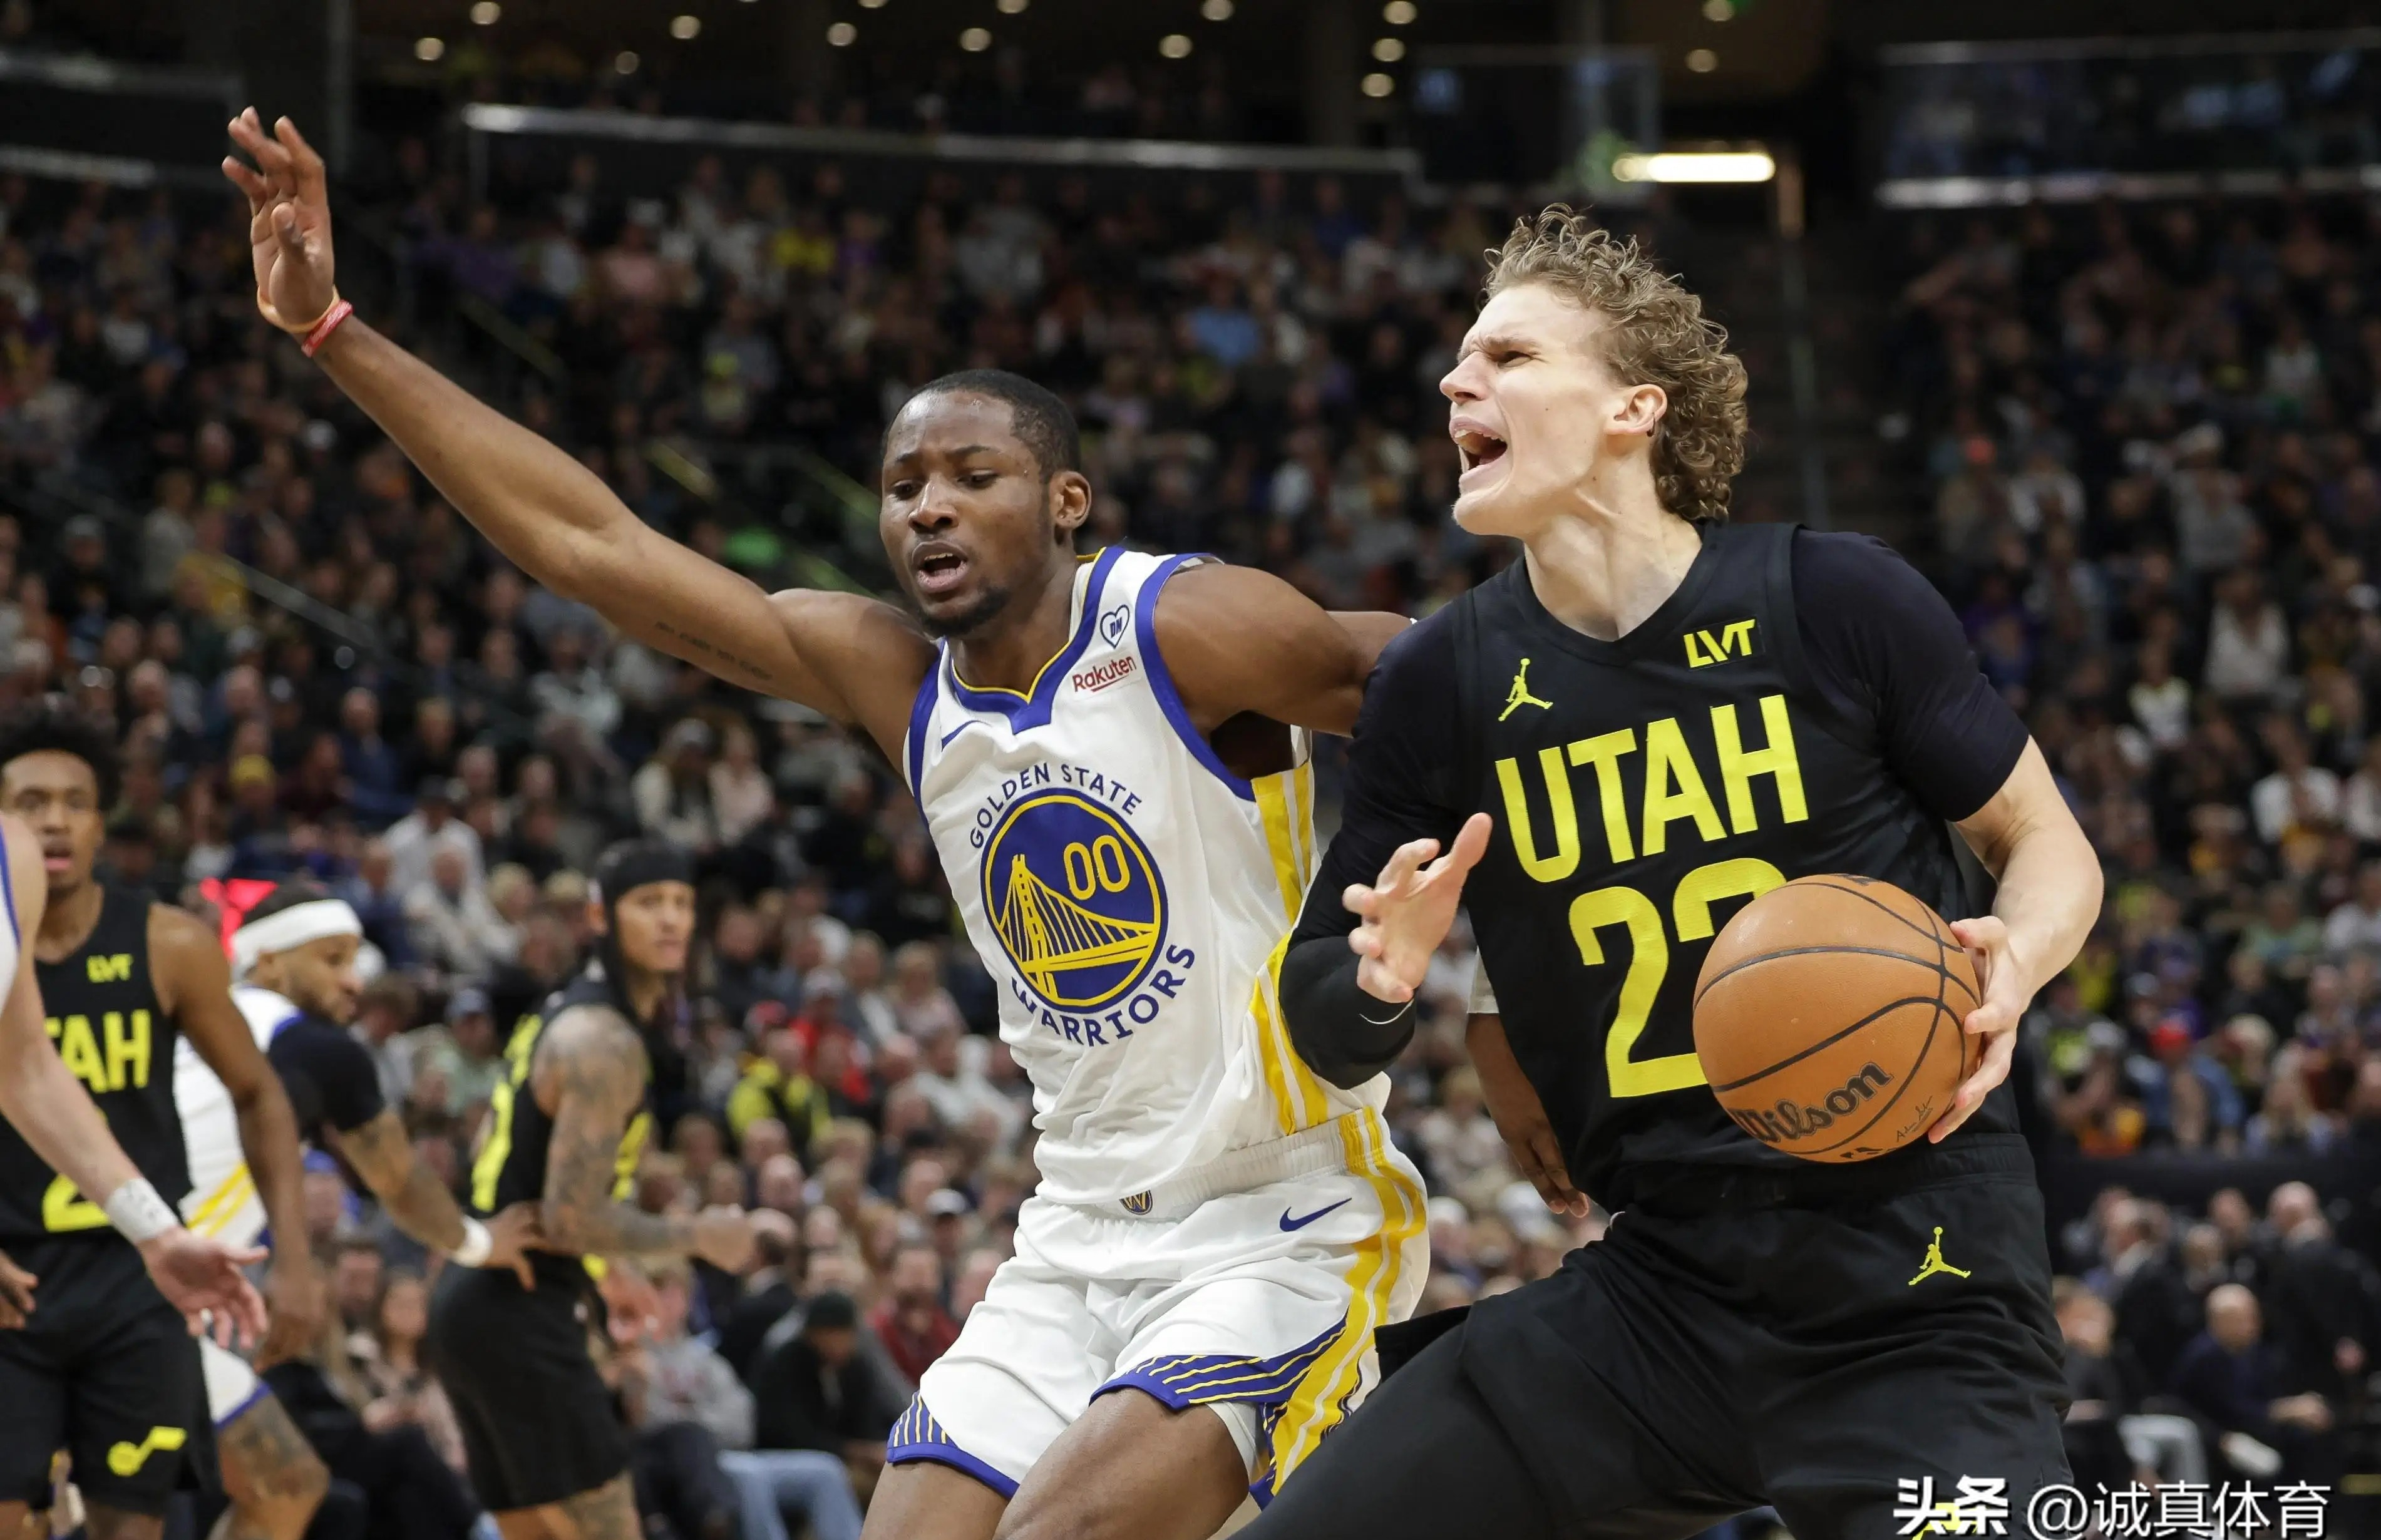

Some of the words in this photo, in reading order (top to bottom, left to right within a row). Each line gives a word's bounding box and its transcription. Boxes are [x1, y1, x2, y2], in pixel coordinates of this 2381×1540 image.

[1109, 617, 1123, 639] DM
[1684, 620, 1756, 668] LVT
[1072, 655, 1137, 692] Rakuten
[969, 762, 1051, 850] GOLDEN
[1061, 764, 1143, 816] STATE
[1495, 694, 1809, 883] UTAH
[1064, 835, 1131, 900] 00
[1010, 944, 1195, 1047] WARRIORS
[1726, 1061, 1895, 1143] Wilson
